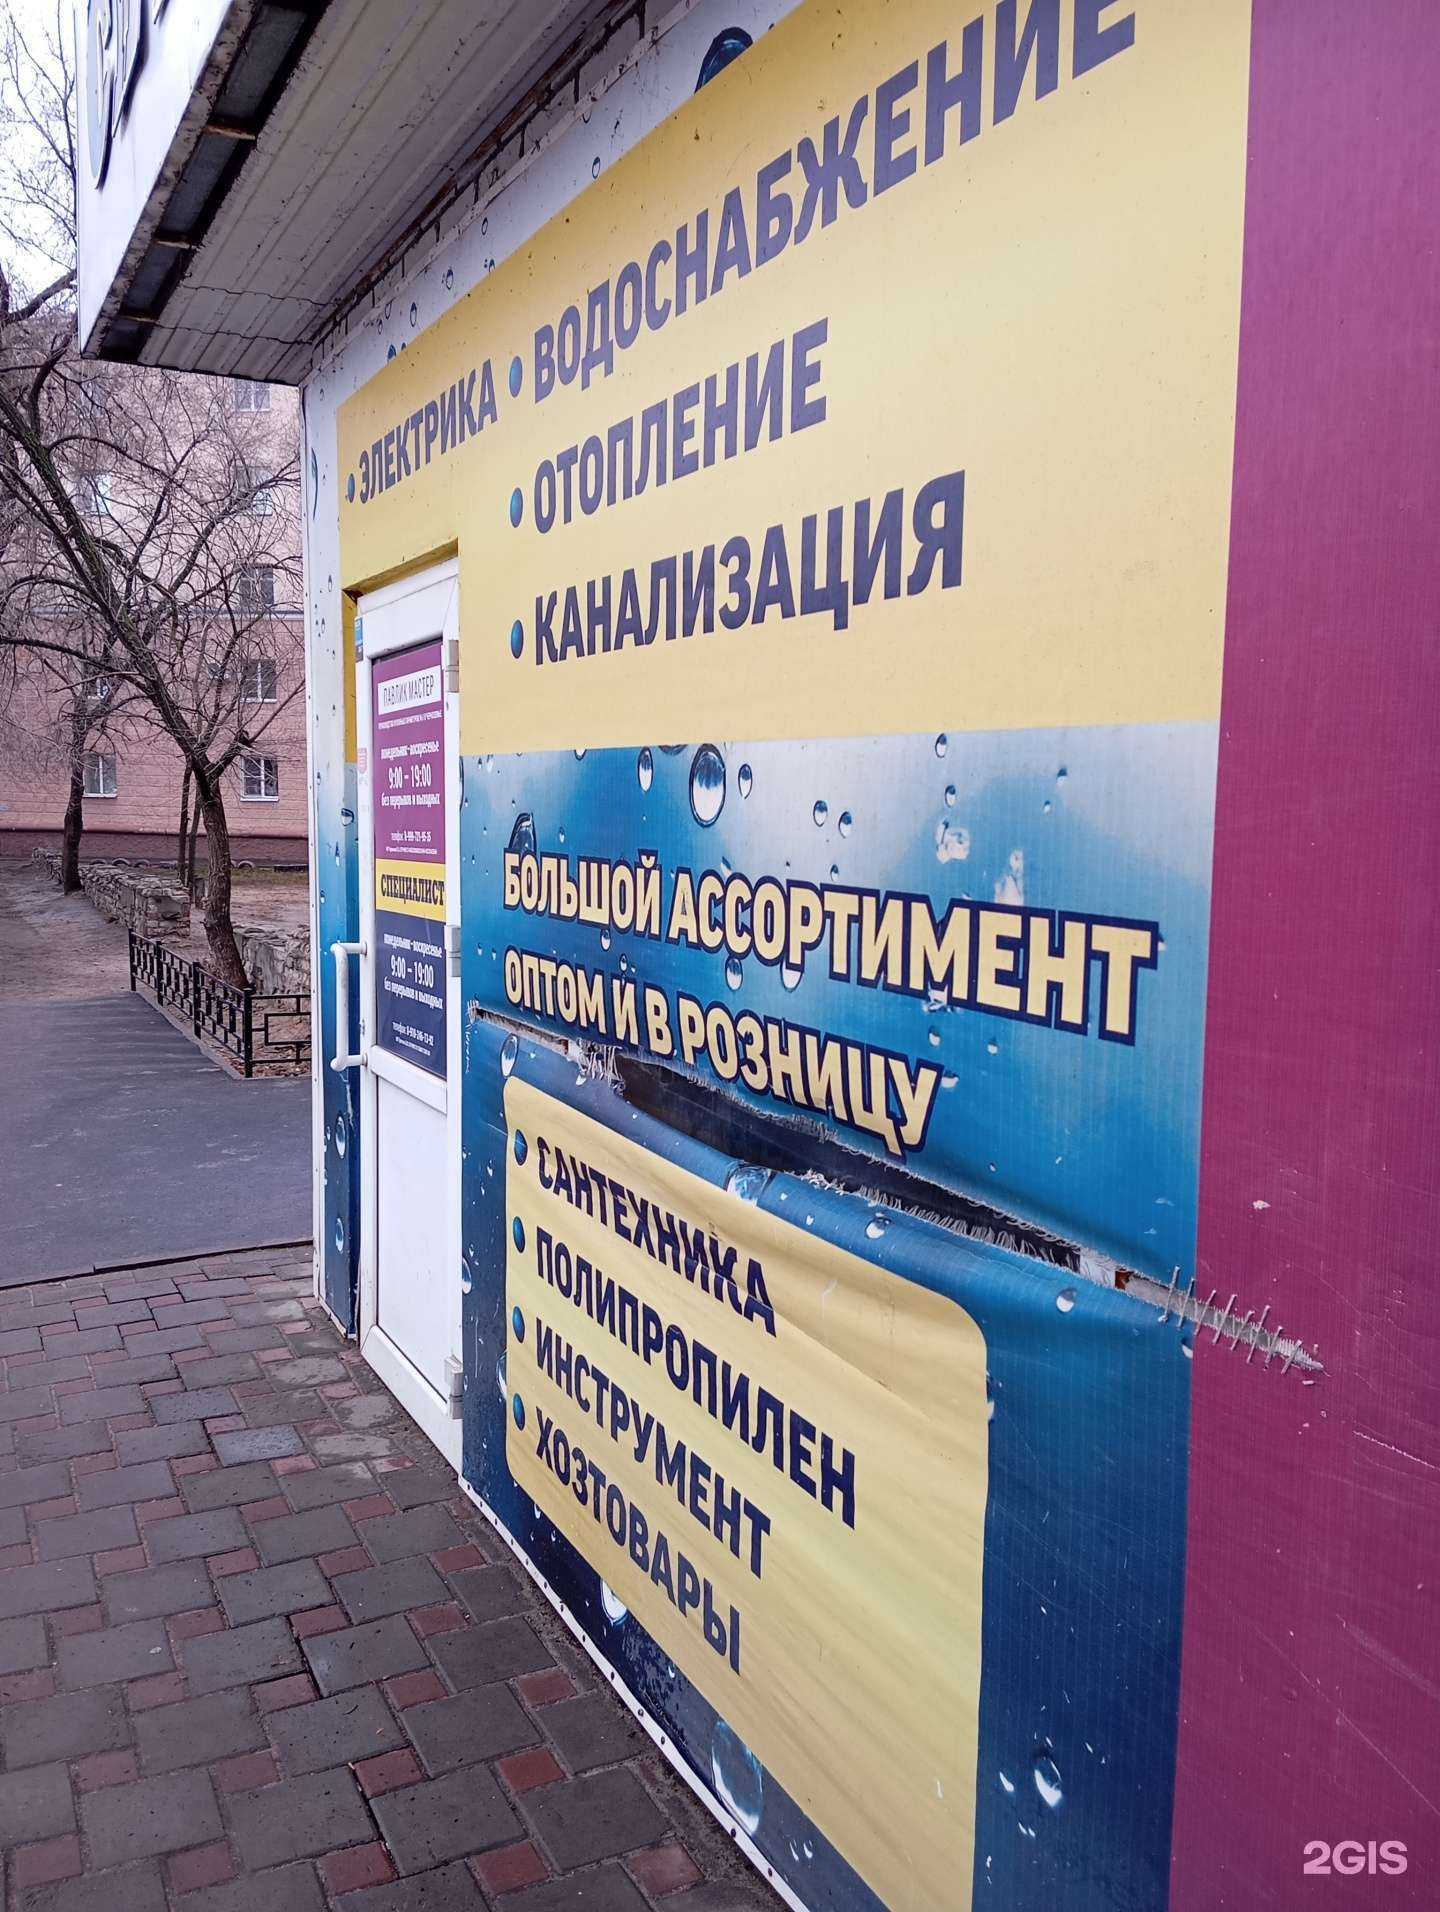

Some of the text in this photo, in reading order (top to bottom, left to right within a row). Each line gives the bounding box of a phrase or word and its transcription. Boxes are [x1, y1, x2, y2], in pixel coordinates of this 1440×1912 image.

[359, 358, 498, 504] ЭЛЕКТРИКА
[534, 317, 829, 534] ОТОПЛЕНИЕ
[535, 470, 966, 665] КАНАЛИЗАЦИЯ
[384, 674, 434, 707] ПАВЛИК МАСТЕР
[388, 766, 403, 789] 9:00
[411, 763, 432, 788] 19:00
[381, 874, 445, 905] СПЕЦИАЛИСТ
[391, 955, 406, 979] 9:00
[414, 961, 434, 988] 19:00
[503, 847, 1160, 1046] БОЛЬШОЙ АССОРТИМЕНТ
[503, 947, 946, 1163] ОПТОМ И В РОЗНИЦУ
[537, 1137, 777, 1337] САНТЕХНИКА
[536, 1226, 856, 1530] ПОЛИПРОПИЛЕН
[536, 1316, 772, 1580] ИНСТРУМЕНТ
[536, 1406, 741, 1676] ХОЗТОВАРЫ
